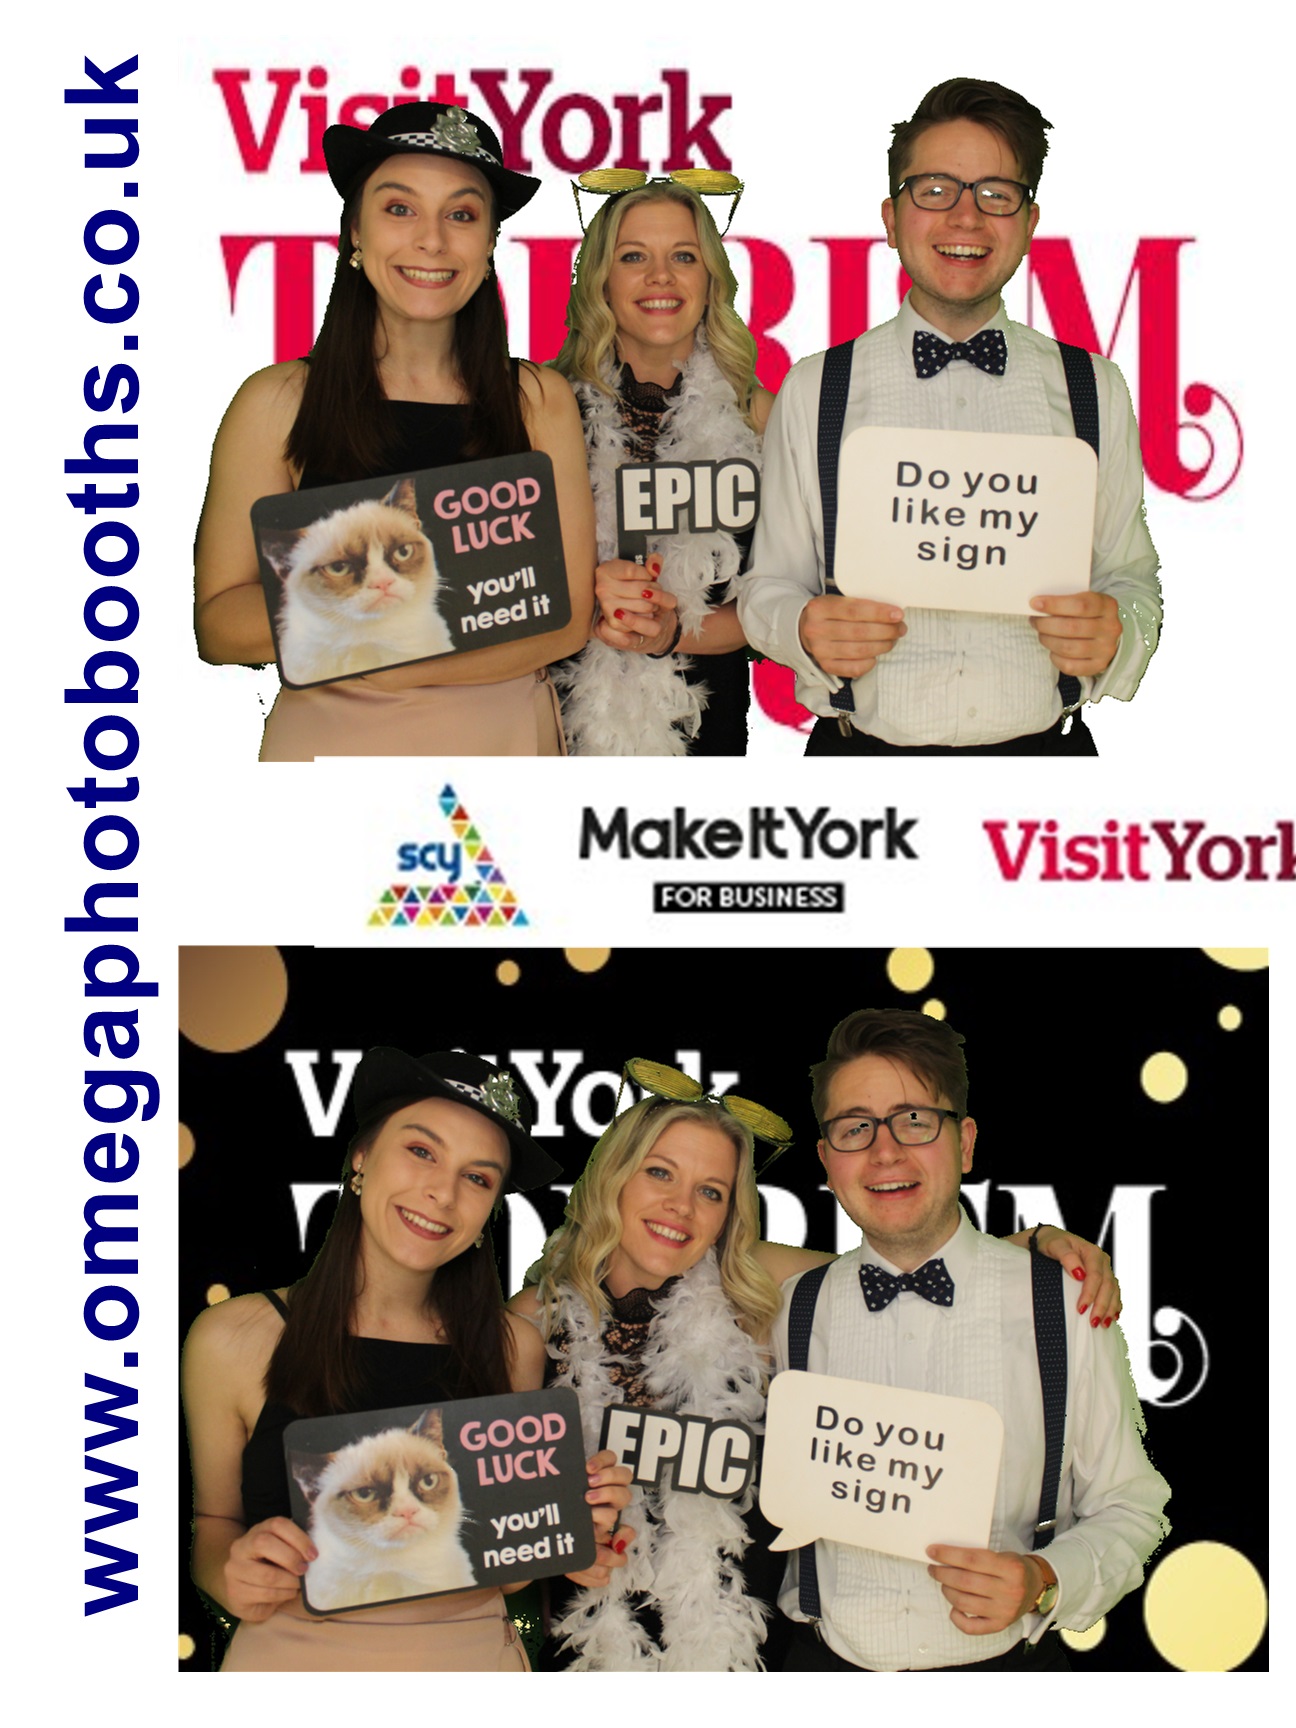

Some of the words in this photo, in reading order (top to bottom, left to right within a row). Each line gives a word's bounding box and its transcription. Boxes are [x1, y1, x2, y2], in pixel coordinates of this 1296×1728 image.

[433, 477, 541, 520] GOOD
[622, 464, 756, 531] EPIC
[897, 461, 950, 489] Do
[962, 471, 1038, 499] you
[451, 511, 536, 554] LUCK
[892, 496, 965, 527] like
[980, 509, 1038, 538] my
[917, 536, 1006, 571] sign
[466, 566, 537, 606] you'll
[460, 598, 528, 634] need
[532, 594, 550, 617] it
[459, 1413, 566, 1453] GOOD
[816, 1405, 864, 1436] Do
[873, 1422, 944, 1451] you
[476, 1447, 560, 1487] LUCK
[606, 1409, 750, 1494] EPIC
[810, 1437, 876, 1473] like
[888, 1457, 944, 1490] my
[831, 1478, 912, 1514] sign
[490, 1502, 561, 1540] you'll
[483, 1536, 551, 1569] need
[555, 1532, 576, 1556] it
